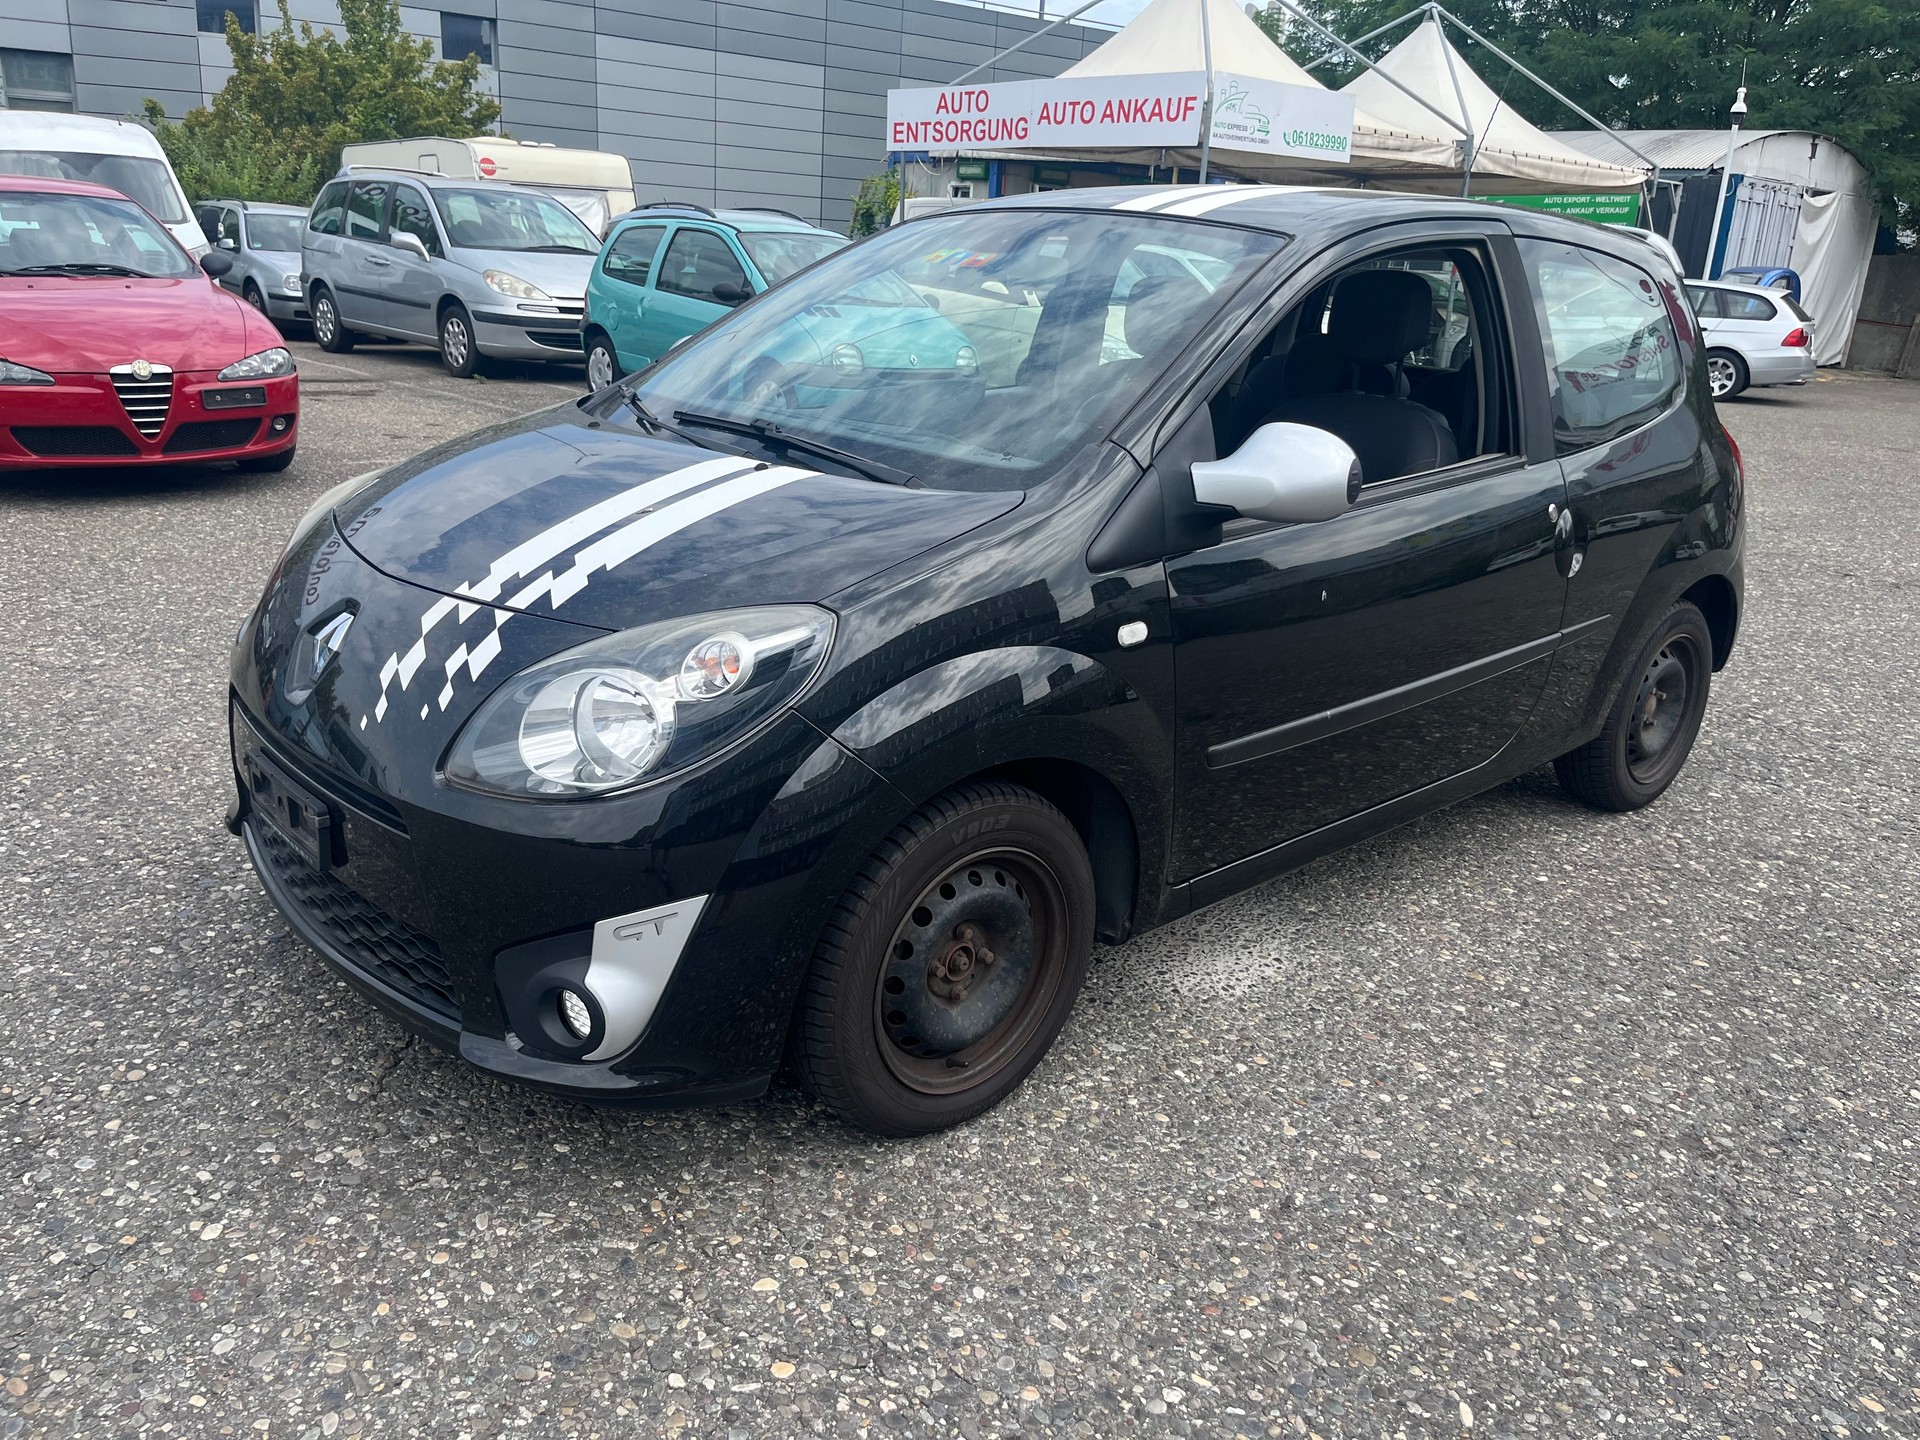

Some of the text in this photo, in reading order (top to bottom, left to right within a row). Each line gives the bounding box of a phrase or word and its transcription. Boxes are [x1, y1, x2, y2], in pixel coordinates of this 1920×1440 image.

[936, 90, 989, 114] AUTO
[1037, 96, 1198, 126] AUTO ANKAUF
[893, 116, 1028, 143] ENTSORGUNG
[1214, 121, 1249, 132] AUTO EXPRESS
[1292, 130, 1348, 151] 0618239990
[1566, 207, 1595, 215] ANKAUF
[1596, 206, 1630, 214] VERKAUF
[613, 911, 678, 941] GT
